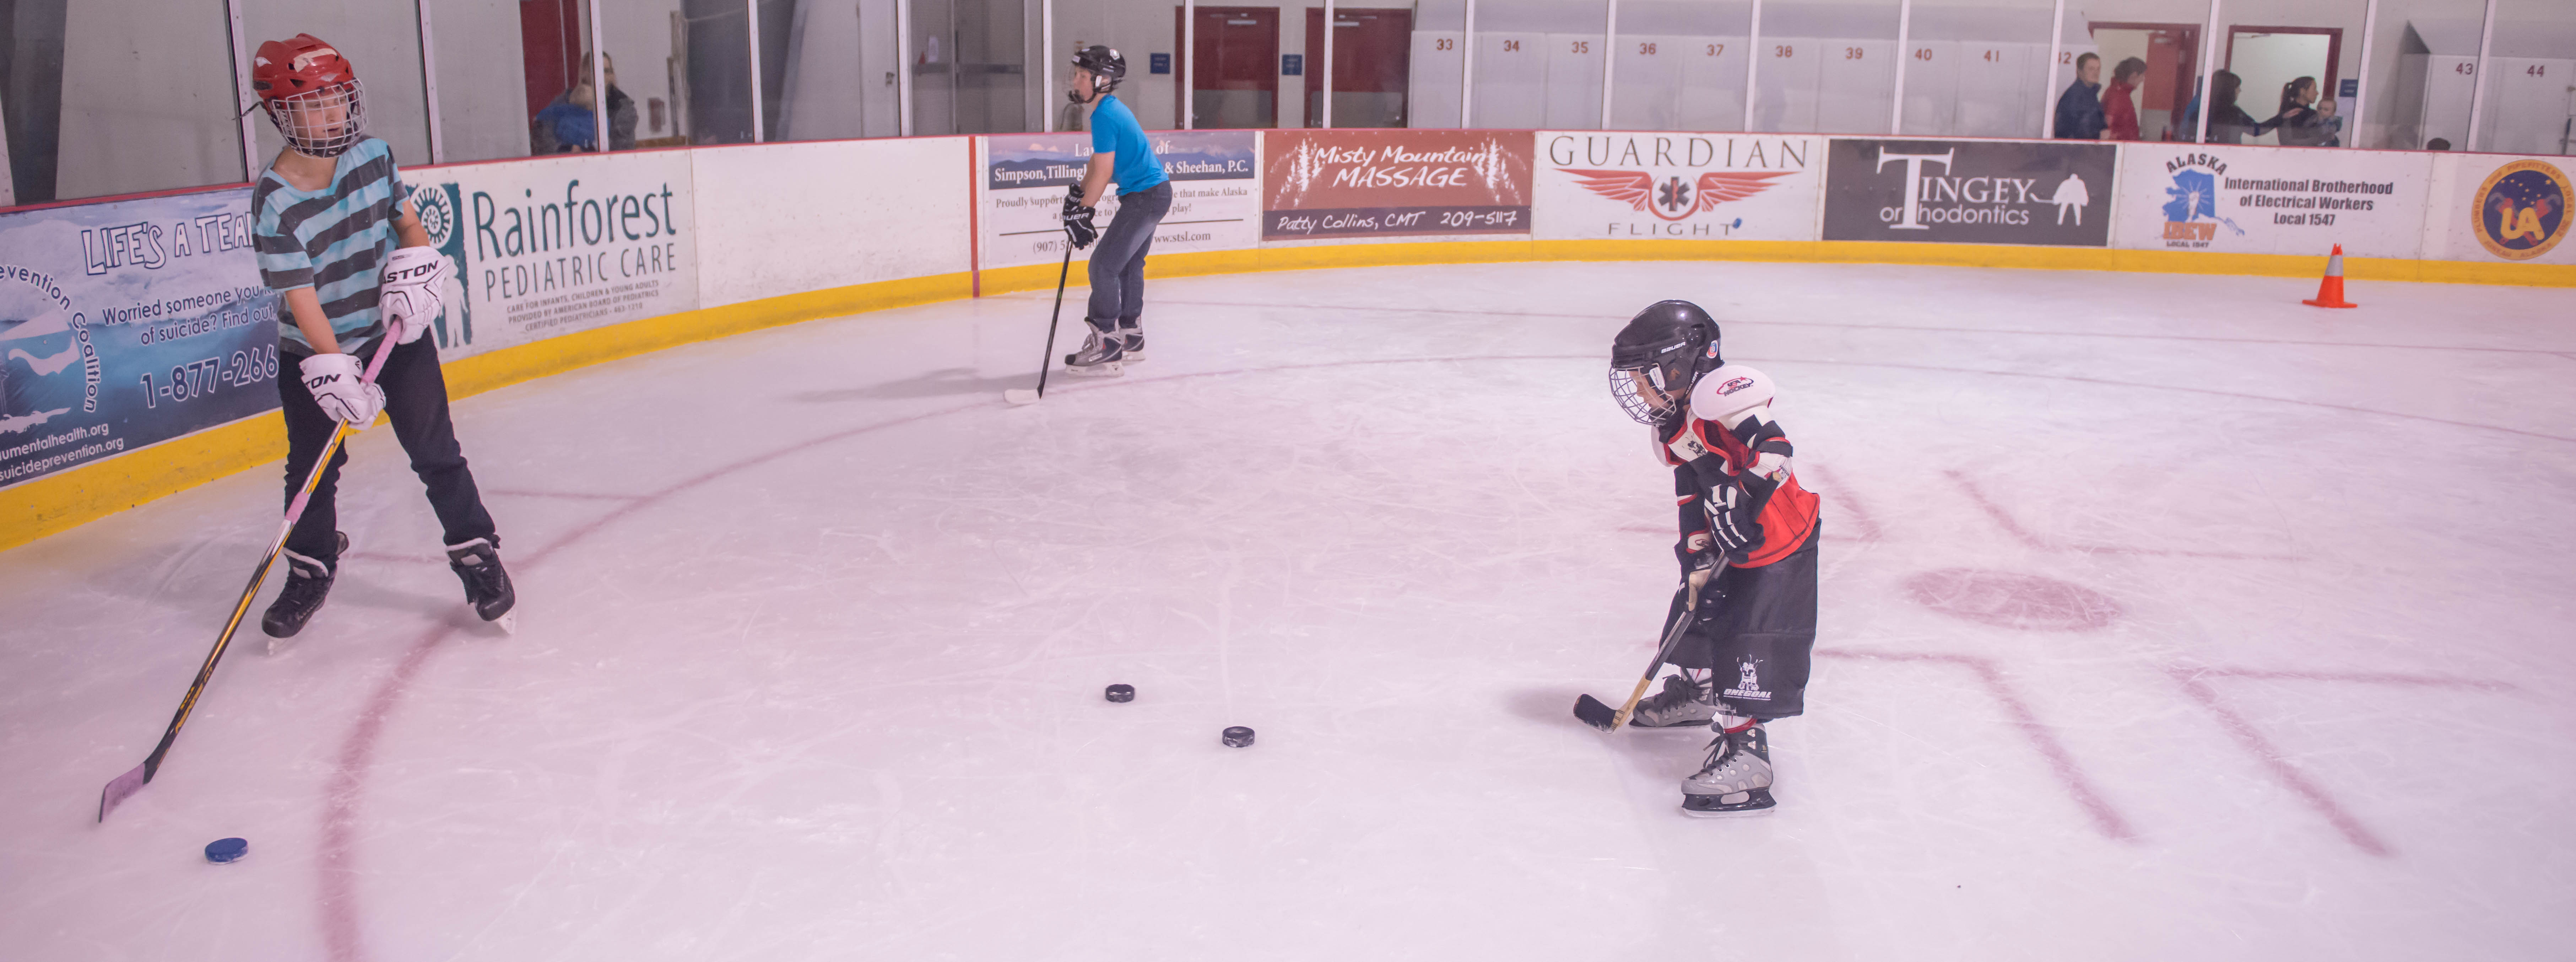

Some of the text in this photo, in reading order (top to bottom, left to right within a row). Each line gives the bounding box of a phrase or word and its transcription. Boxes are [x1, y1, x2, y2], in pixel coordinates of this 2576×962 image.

[1436, 39, 1453, 50] 33
[1504, 40, 1520, 52] 34
[1571, 42, 1589, 53] 35
[1639, 43, 1656, 55] 36
[1706, 44, 1724, 57] 37
[1776, 45, 1792, 58] 38
[1846, 47, 1863, 59] 39
[1915, 48, 1932, 61] 40
[1984, 50, 2000, 62] 41
[2455, 63, 2473, 75] 43
[2527, 65, 2545, 77] 44
[1156, 140, 1170, 155] of
[1549, 135, 1808, 168] GUARDIAN
[1314, 145, 1488, 167] Misty Mountain
[1164, 162, 1174, 174] &
[1176, 160, 1225, 174] Sheehan,
[1228, 160, 1249, 172] P.C.
[2166, 153, 2228, 176] ALASKA
[1332, 166, 1468, 188] MASSAGE
[1876, 145, 2036, 230] TINGEY
[2224, 177, 2394, 194] International Brotherhood
[996, 197, 1028, 209] Proudly
[1180, 189, 1196, 198] that
[1198, 188, 1219, 197] make
[1221, 187, 1248, 196] Alaska
[2239, 194, 2374, 211] of Electrical Workers
[1172, 203, 1191, 215] play!
[473, 179, 676, 262] Rainforest
[1277, 211, 1518, 235] Patty Collins, CMT 209-5117
[2273, 213, 2336, 226] Local 1547
[2501, 207, 2545, 241] UA
[1608, 222, 1731, 236] FLIGHT
[2163, 221, 2217, 241] IBEW
[82, 211, 254, 275] LIFE'S A TEA
[1033, 241, 1057, 254] (907)
[485, 242, 676, 302] PEDIATRIC CARE
[507, 303, 523, 313] CARE
[526, 301, 539, 310] FOR
[571, 289, 603, 301] CHILDREN
[611, 284, 633, 293] YOUNG
[635, 279, 659, 290] ADULTS
[103, 285, 259, 327] Worried someone you
[508, 310, 542, 324] PROVIDED
[544, 309, 551, 317] BY
[554, 302, 587, 315] AMERICAN
[589, 297, 611, 308] BOARD
[623, 289, 659, 302] PEDIATRICS
[141, 327, 156, 345] of
[159, 314, 217, 343] suicide?
[222, 307, 249, 328] Find
[525, 318, 558, 332] CERTIFIED
[560, 307, 608, 324] PEDIATRICIANS
[1661, 342, 1686, 354] BAUER
[72, 312, 100, 413] Coalition
[1723, 383, 1751, 397] HOCKEY
[1723, 688, 1771, 698] ONEGOAL
